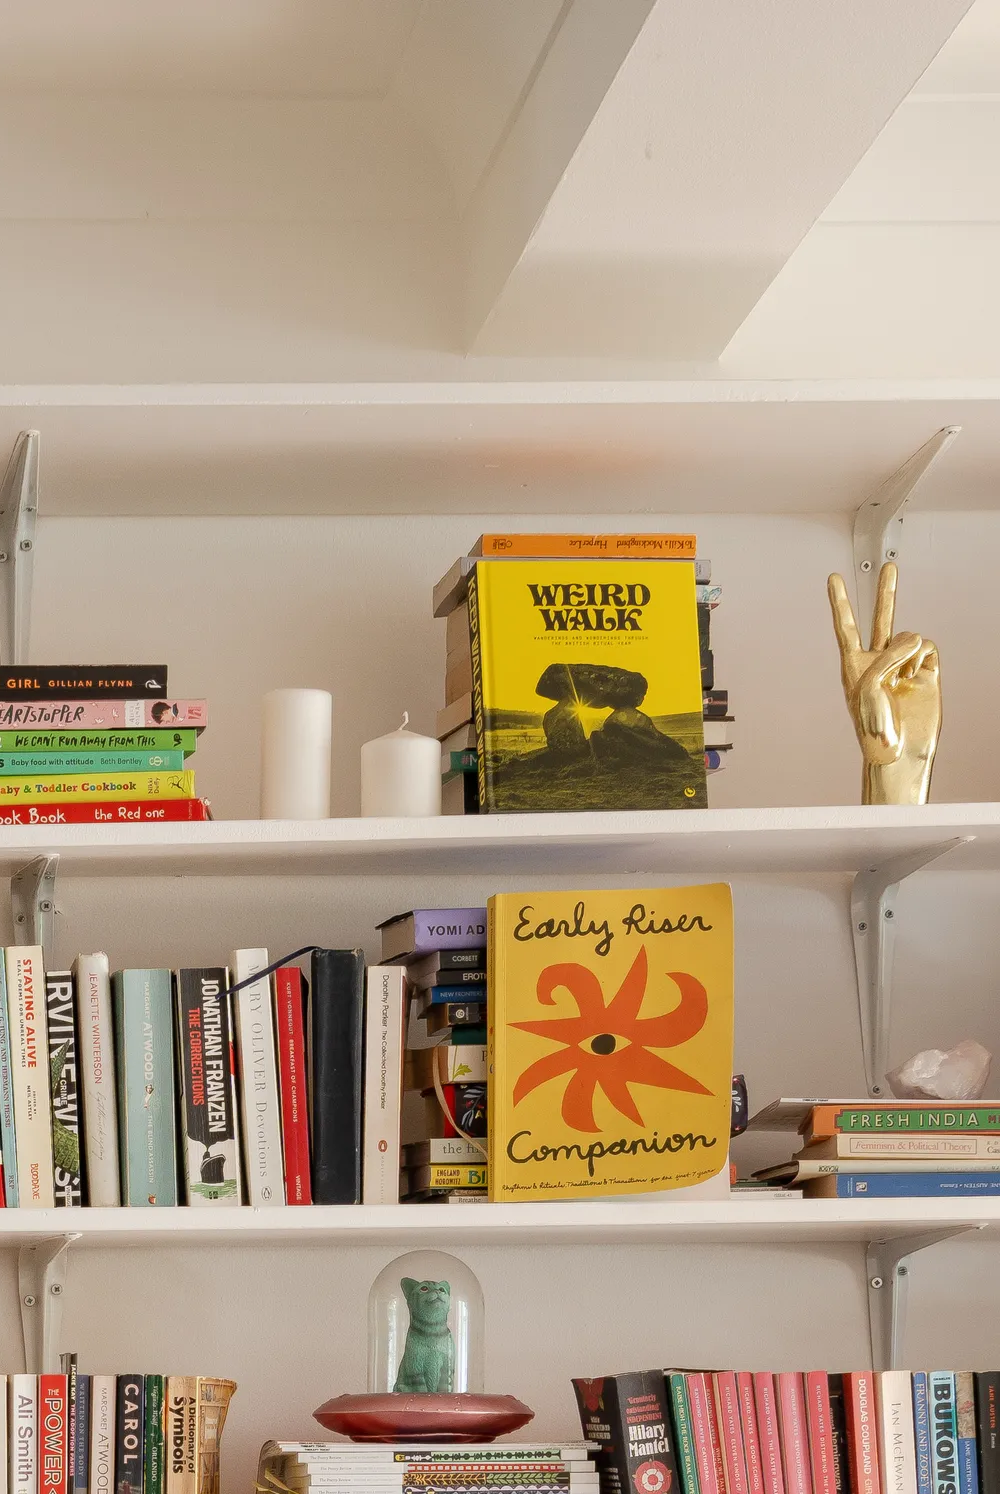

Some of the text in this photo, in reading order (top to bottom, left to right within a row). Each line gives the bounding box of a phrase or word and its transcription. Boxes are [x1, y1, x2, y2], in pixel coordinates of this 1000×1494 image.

[527, 584, 650, 607] WEIRD
[539, 608, 642, 632] WALK
[7, 679, 40, 689] GIRL
[49, 680, 133, 688] GILLIAN FLYNN
[15, 734, 156, 747] WE CAN'T RUN AWAY FROM THIS
[11, 757, 94, 768] Baby food with attitude
[100, 757, 142, 766] Beth Bentley
[23, 785, 32, 793] &
[35, 783, 78, 794] Toddler
[81, 781, 136, 792] Cookbook
[29, 809, 66, 824] Book
[95, 807, 164, 821] the Red one
[427, 925, 462, 936] YOMI
[514, 901, 713, 956] Early Riser
[23, 959, 36, 1068] STAYING ALIVE
[381, 975, 390, 1027] Dorothy Parker
[88, 973, 102, 1084] JEANETTE WINTERSON
[143, 1022, 154, 1080] ATWOOD
[188, 1008, 204, 1105] THE CORRECTIONS
[201, 978, 226, 1132] JONATHAN FRANZEN
[251, 1023, 270, 1177] OLIVER Devotions
[850, 1113, 979, 1127] FRESH INDIA
[507, 1130, 716, 1176] Companion
[855, 1141, 972, 1152] Feminism & Political Theory
[18, 1395, 33, 1424] Ali
[188, 1397, 196, 1405] A
[816, 1385, 824, 1412] RICHARD
[123, 1383, 139, 1464] CAROL
[168, 1397, 188, 1473] Symbols
[187, 1413, 196, 1460] Dictionary
[628, 1424, 665, 1441] Hilary
[18, 1426, 33, 1482] Smith
[44, 1397, 63, 1485] POWER
[629, 1439, 670, 1458] Mantel
[819, 1437, 828, 1473] DISTURBING
